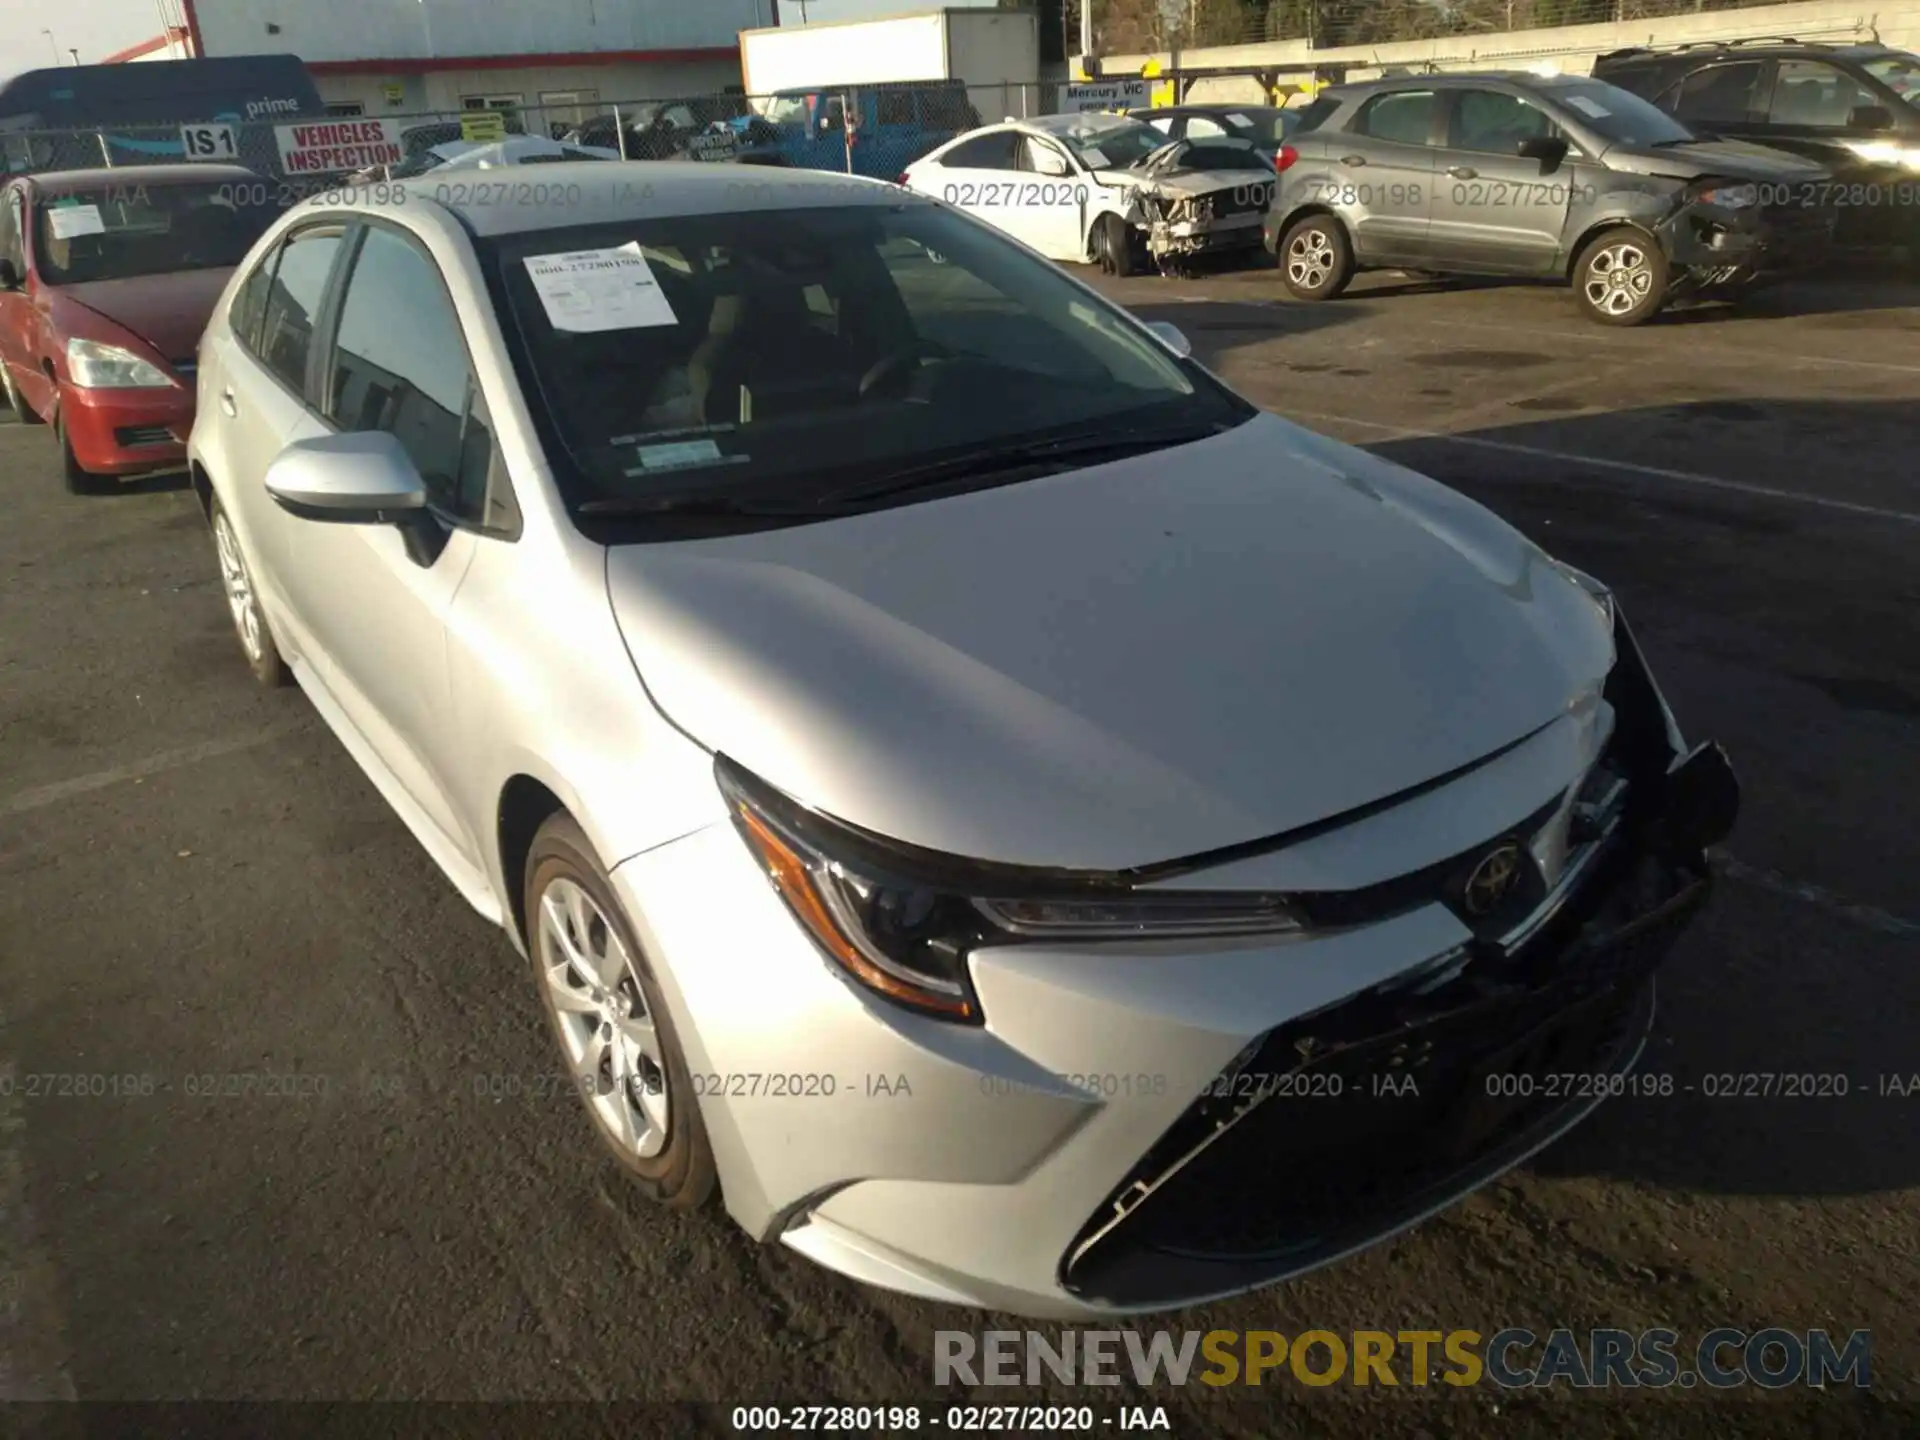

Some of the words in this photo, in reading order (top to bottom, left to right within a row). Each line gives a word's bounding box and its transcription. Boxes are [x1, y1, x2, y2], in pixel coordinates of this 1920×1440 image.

[1067, 87, 1118, 98] Mercury
[1124, 83, 1144, 94] VIC
[247, 97, 299, 118] prime
[185, 129, 216, 155] IS
[220, 128, 235, 153] 1
[292, 121, 384, 147] VEHICLES
[285, 144, 402, 171] INSPECTION
